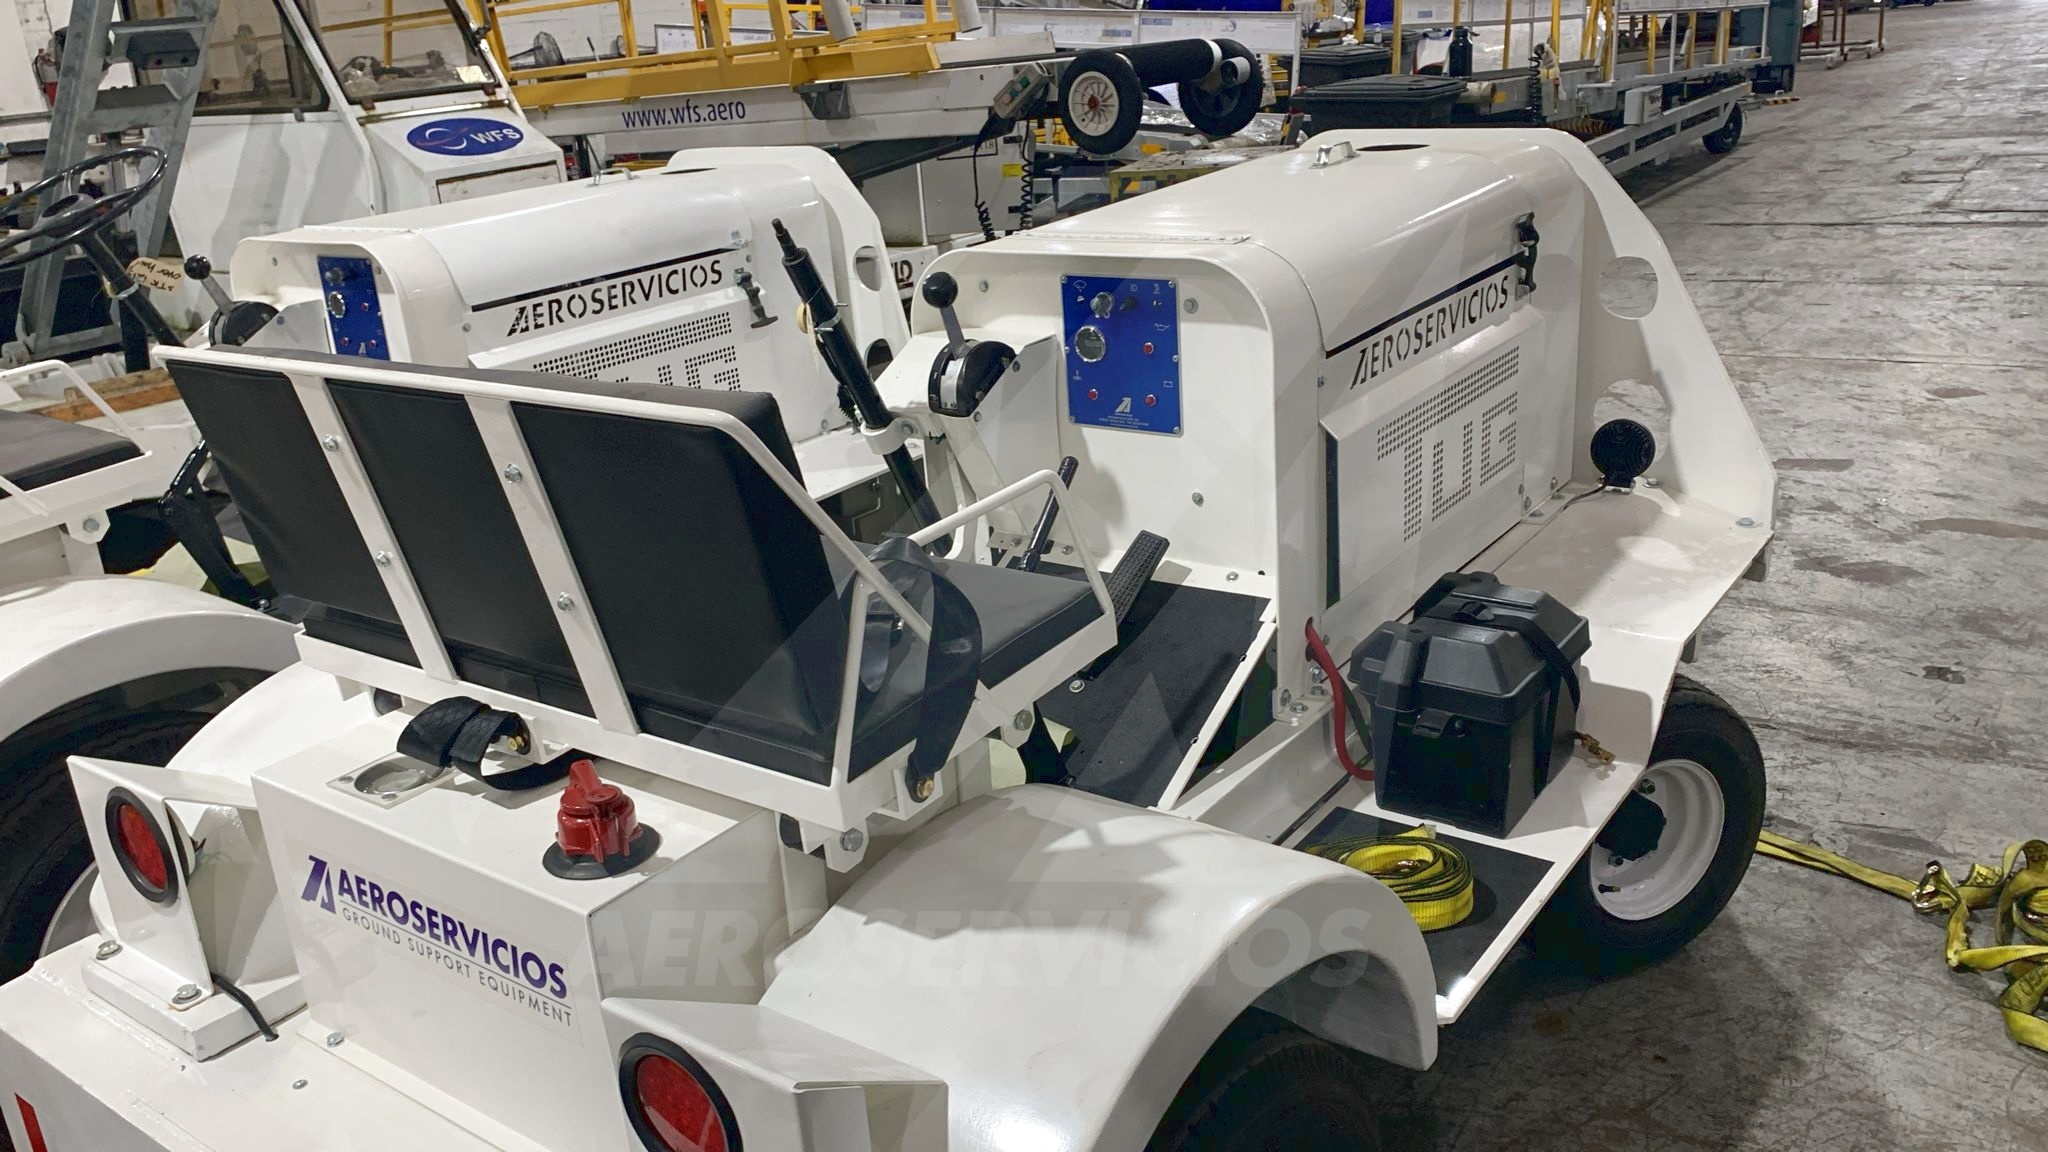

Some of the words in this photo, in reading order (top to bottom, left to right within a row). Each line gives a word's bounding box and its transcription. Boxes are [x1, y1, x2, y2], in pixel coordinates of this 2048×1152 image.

[470, 128, 521, 144] WFS
[622, 98, 746, 128] www.wfs.aero
[507, 259, 722, 337] AEROSERVICIOS
[1350, 275, 1508, 390] AEROSERVICIOS
[1377, 345, 1519, 543] TUG
[338, 868, 567, 999] AEROSERVICIOS
[342, 907, 401, 946] GROUND
[408, 936, 471, 978] SUPPORT
[478, 970, 572, 1027] EQUIPMENT
